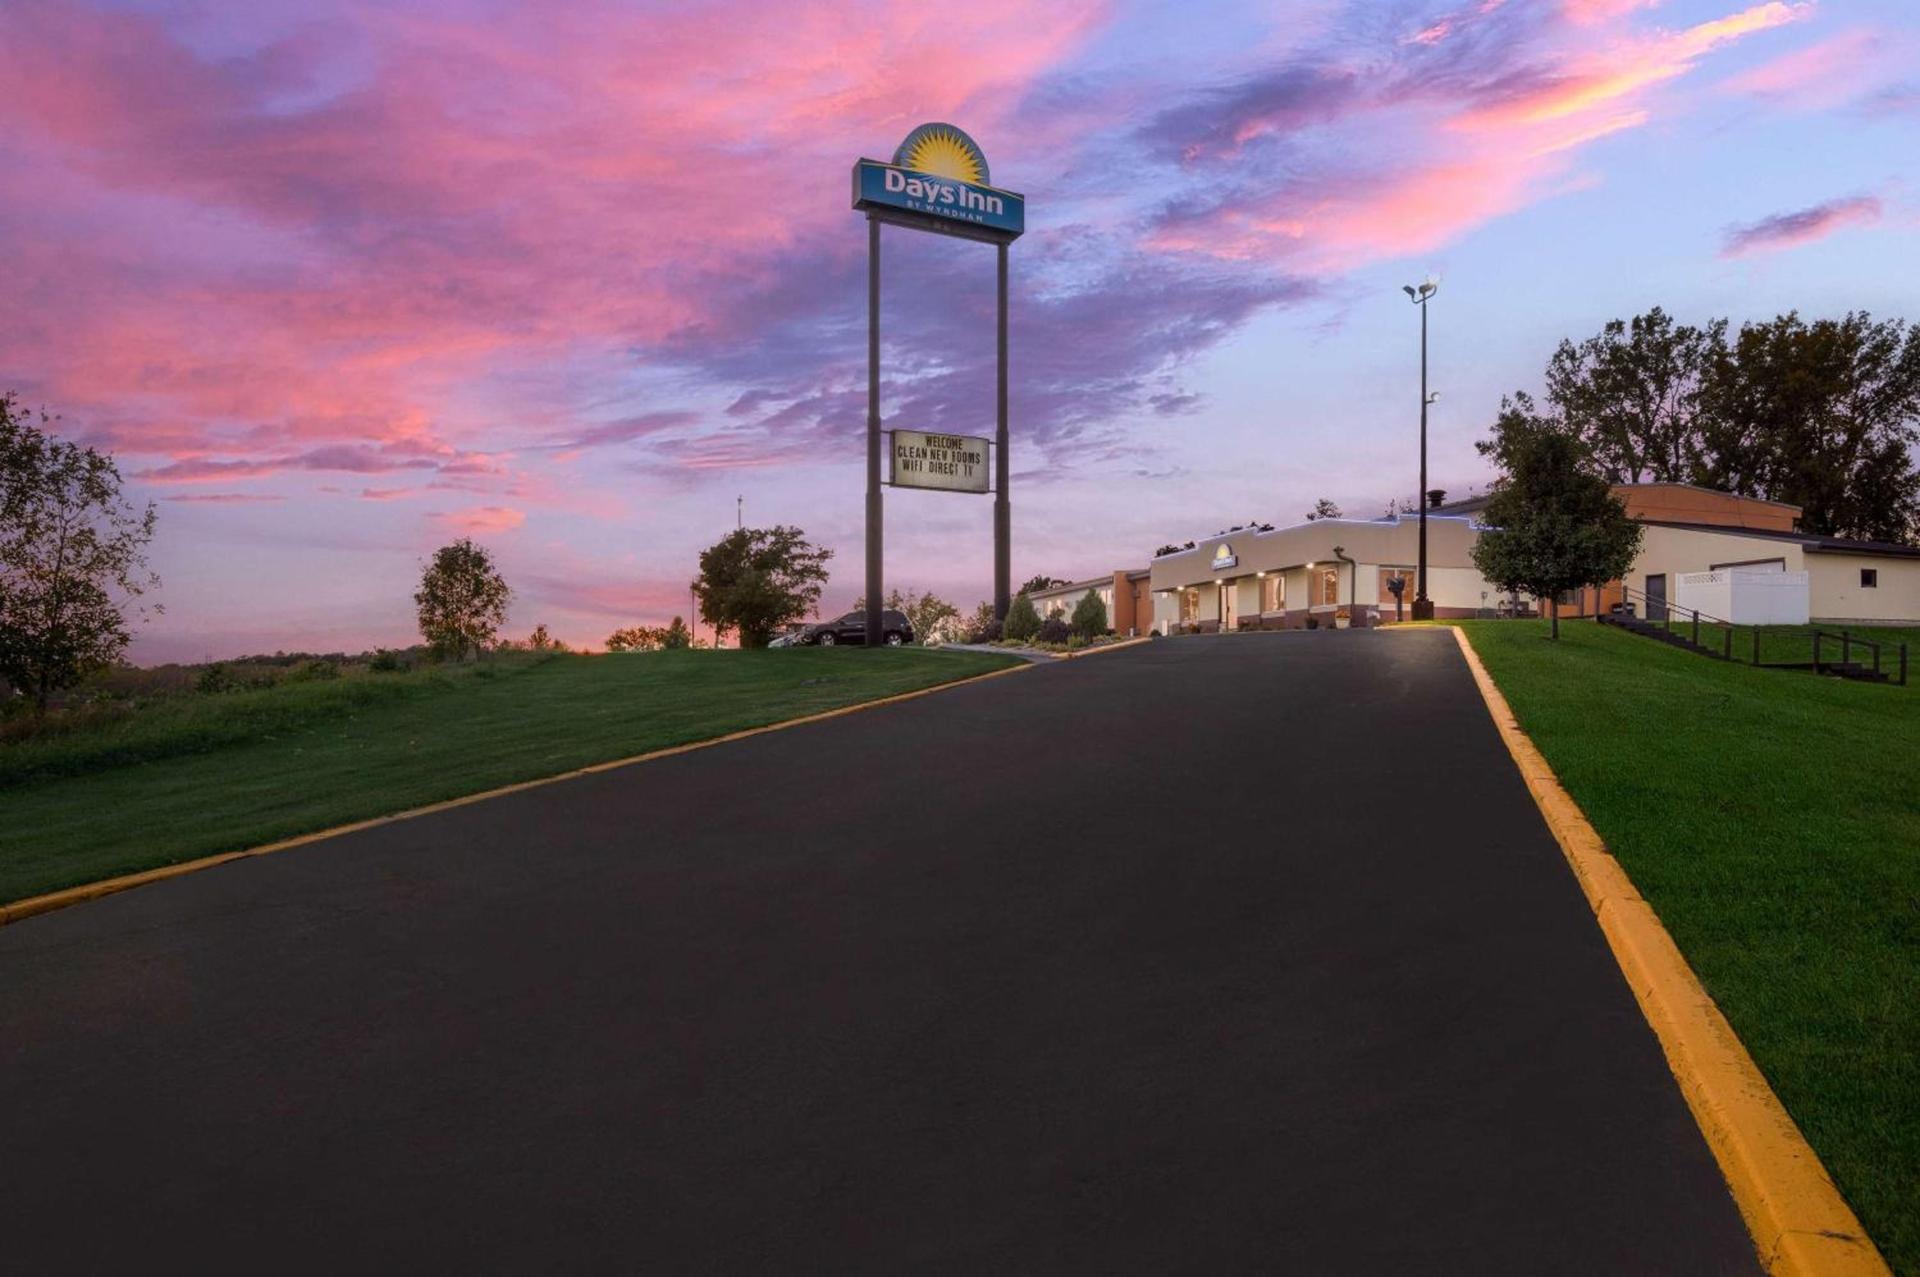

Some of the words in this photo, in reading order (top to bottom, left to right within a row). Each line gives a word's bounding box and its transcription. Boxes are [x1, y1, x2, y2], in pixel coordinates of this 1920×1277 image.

[885, 168, 954, 204] Days
[959, 184, 1004, 216] Inn
[906, 200, 921, 209] BY
[926, 205, 983, 223] WYNDHAM
[925, 435, 963, 450] WELCOME
[897, 445, 928, 459] CLEAN
[930, 449, 948, 461] NEW
[951, 451, 981, 465] ROOMS
[902, 458, 923, 472] WIFI
[928, 461, 959, 476] DIRECT
[964, 465, 974, 477] TV
